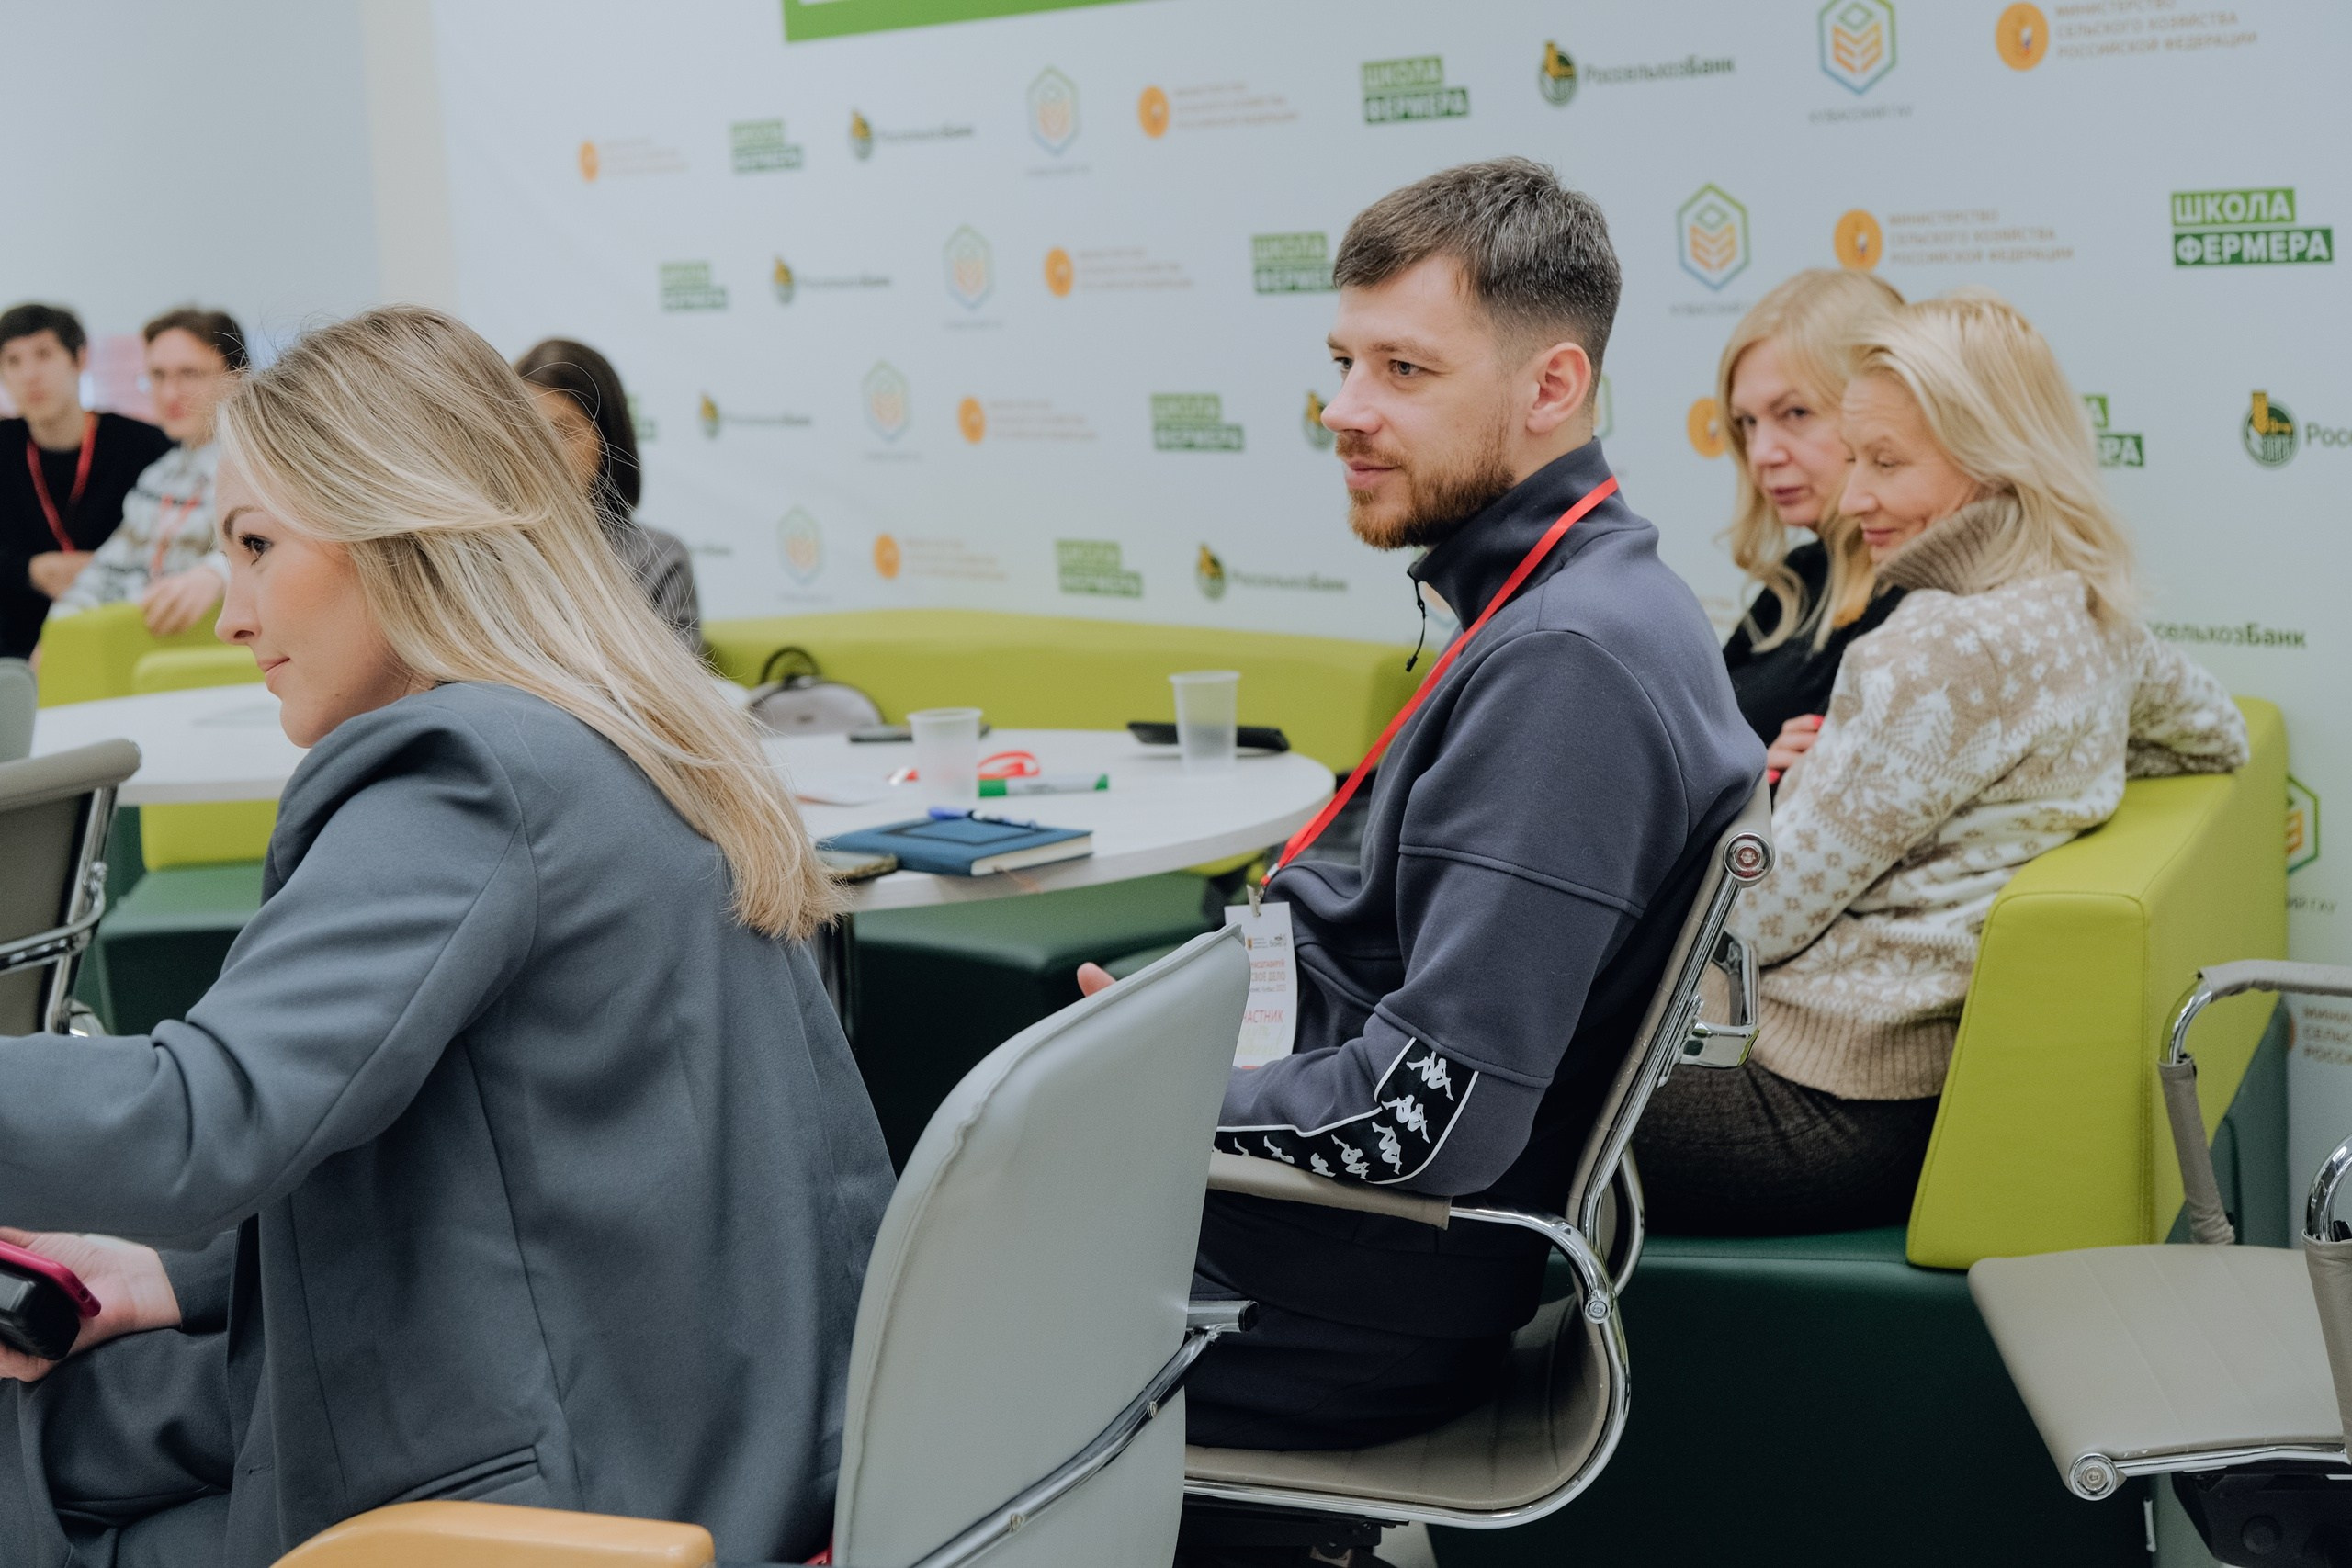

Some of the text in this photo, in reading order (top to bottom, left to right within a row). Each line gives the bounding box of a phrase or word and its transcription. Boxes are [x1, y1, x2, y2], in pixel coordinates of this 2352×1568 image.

[2175, 191, 2292, 225] ШКОЛА
[2176, 231, 2331, 265] ФЕРМЕРА
[1244, 1009, 1283, 1023] АСТНИК
